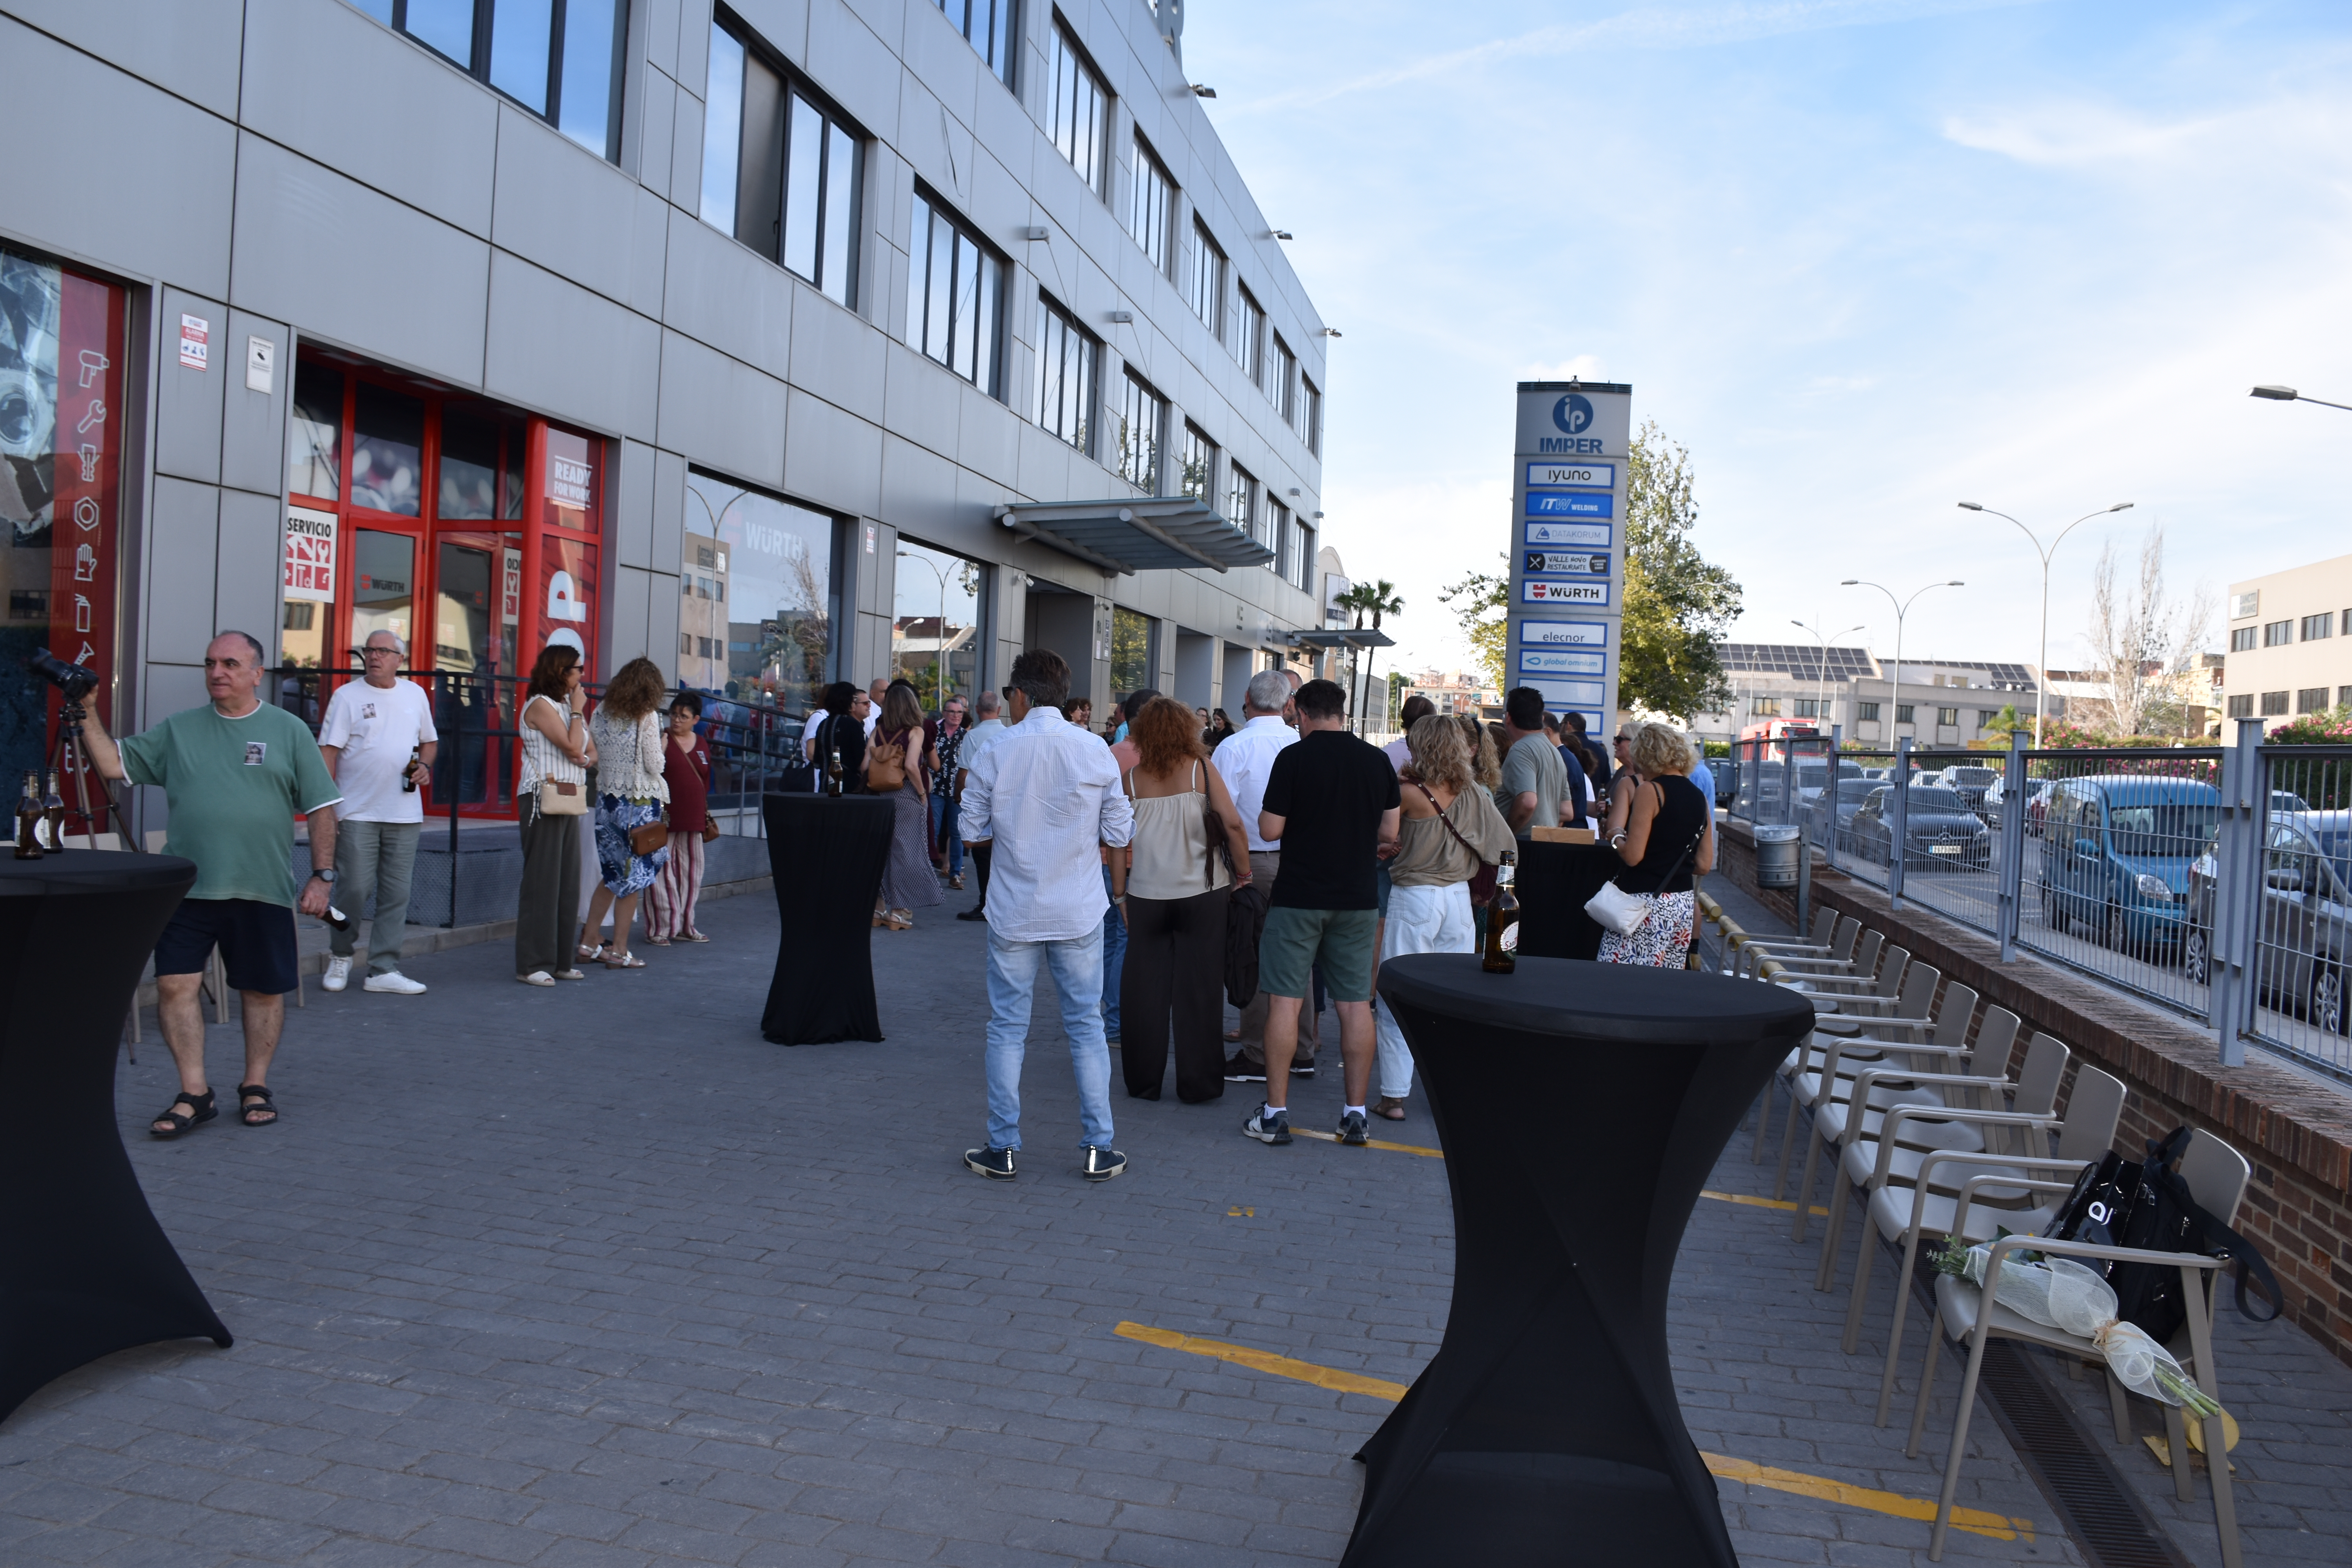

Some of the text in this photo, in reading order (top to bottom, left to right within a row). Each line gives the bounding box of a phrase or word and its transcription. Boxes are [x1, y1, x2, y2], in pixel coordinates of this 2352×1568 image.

[1540, 438, 1603, 454] IMPER
[555, 461, 591, 487] READY
[1548, 468, 1591, 483] iyuno
[554, 481, 591, 502] FOR WORK
[1540, 498, 1572, 510] ITW
[287, 517, 331, 537] SERVICIO
[1552, 530, 1601, 539] DATAKORUM
[746, 522, 803, 561] WÜRTH
[372, 579, 405, 593] WÜRTH
[1550, 588, 1599, 598] WÜRTH
[1543, 632, 1585, 642] elecnor
